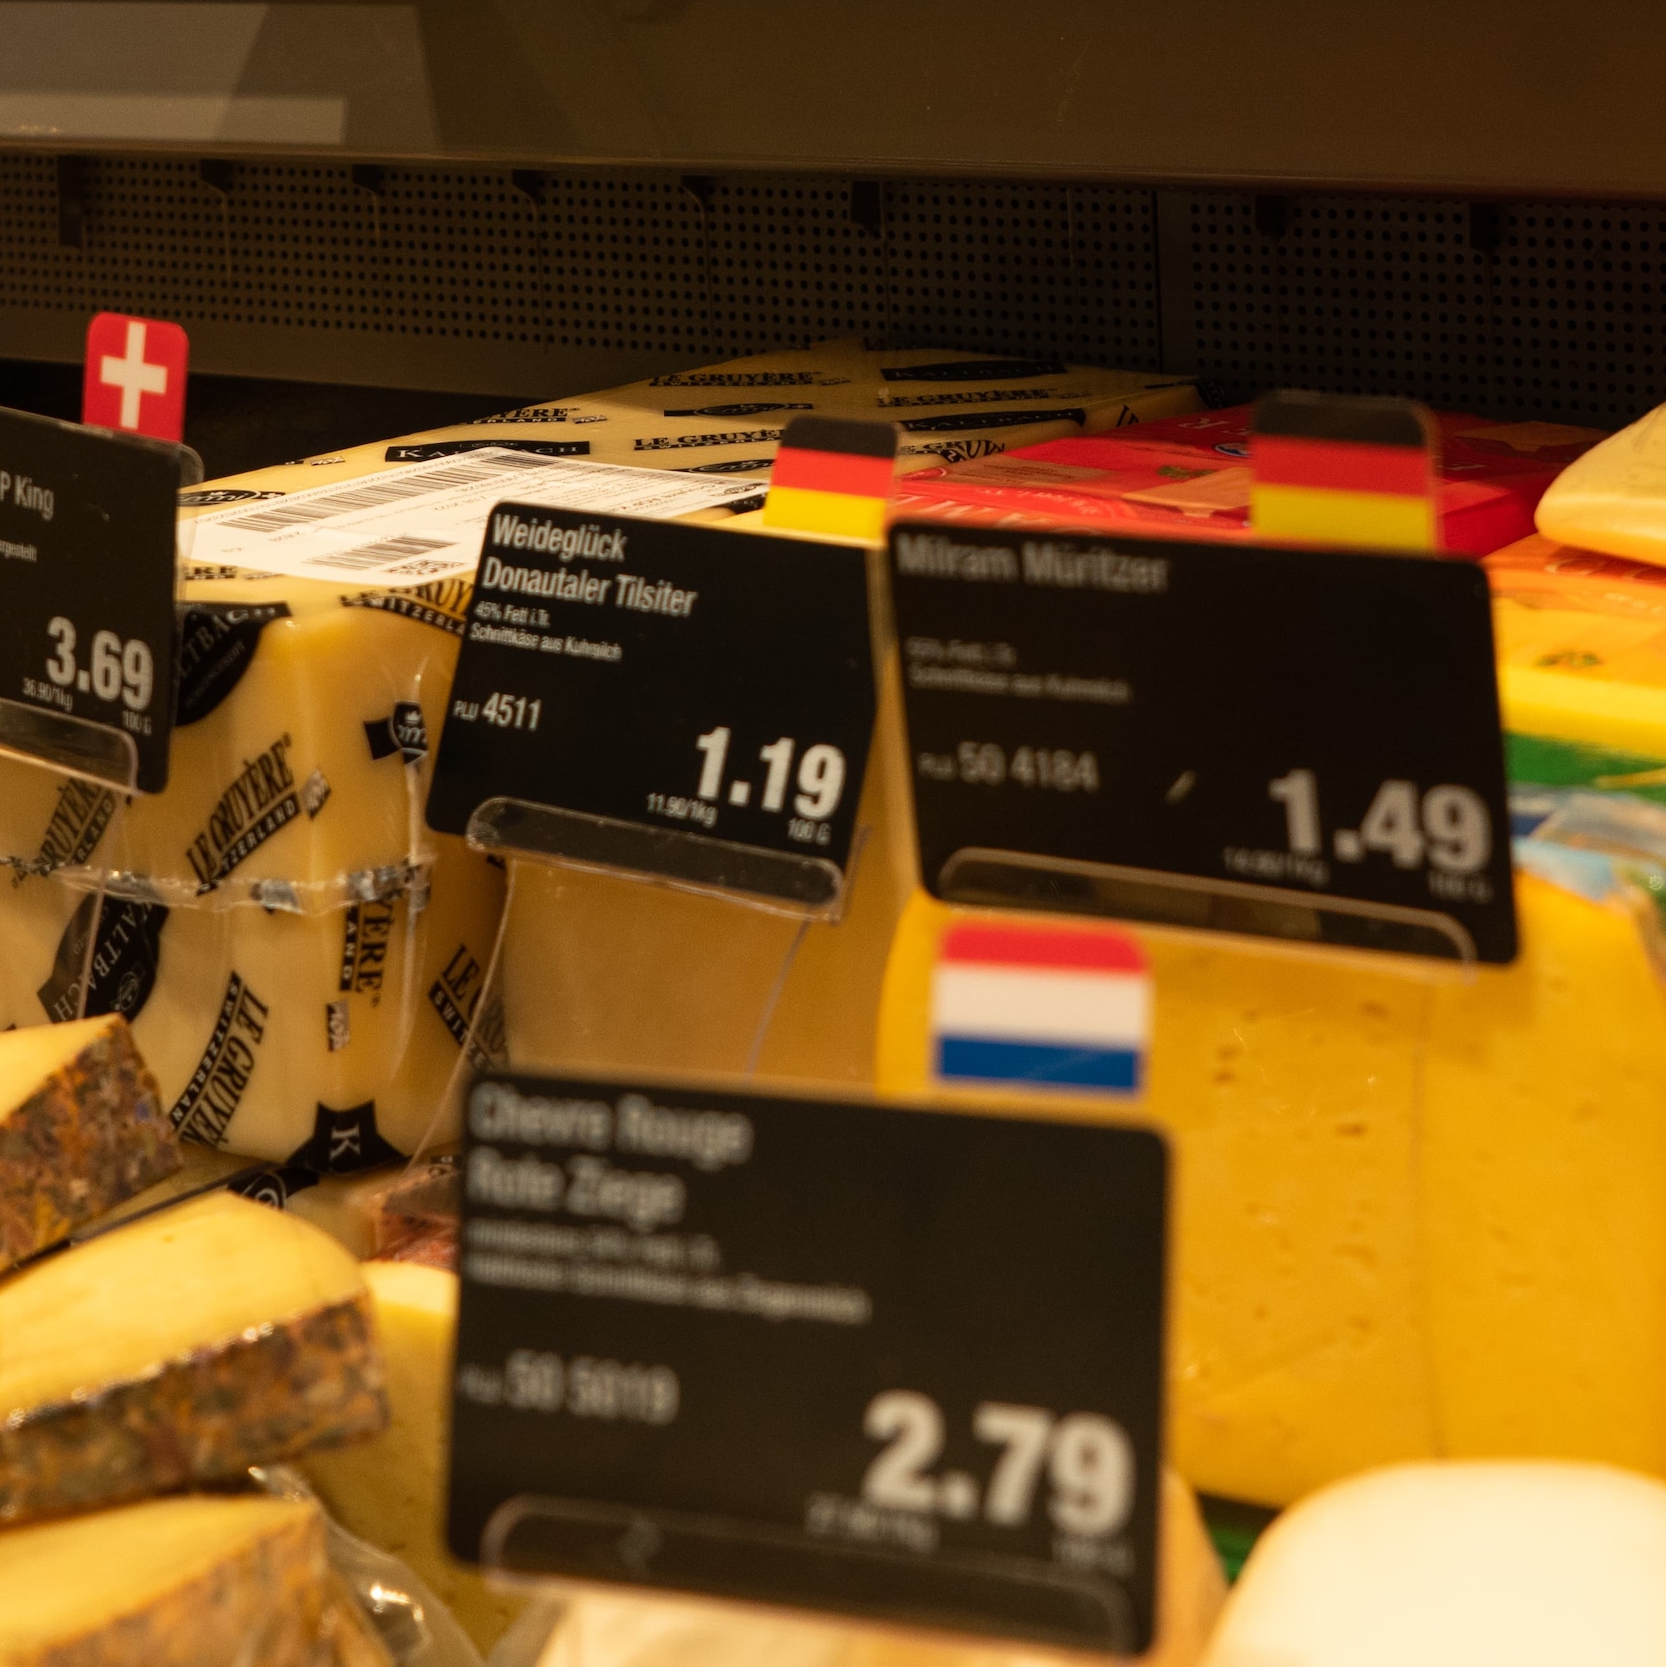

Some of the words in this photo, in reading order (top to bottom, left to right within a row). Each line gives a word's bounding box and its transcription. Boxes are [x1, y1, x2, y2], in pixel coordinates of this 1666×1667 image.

[634, 437, 668, 447] LE
[14, 474, 55, 522] King
[493, 513, 628, 563] Weideglück
[474, 601, 502, 620] 45%
[504, 605, 528, 625] Fett
[483, 556, 611, 605] Donautaler
[615, 574, 698, 617] Tilsiter
[46, 616, 154, 710] 3.69
[471, 623, 539, 649] Schnittkäse
[540, 635, 563, 653] aus
[564, 634, 623, 662] Kuhmilch
[453, 700, 479, 720] PLU
[482, 692, 543, 731] 4511
[695, 726, 847, 821] 1.19
[1268, 768, 1492, 876] 1.49
[172, 984, 239, 1122] SWITZERLAN
[862, 1389, 1134, 1534] 2.79
